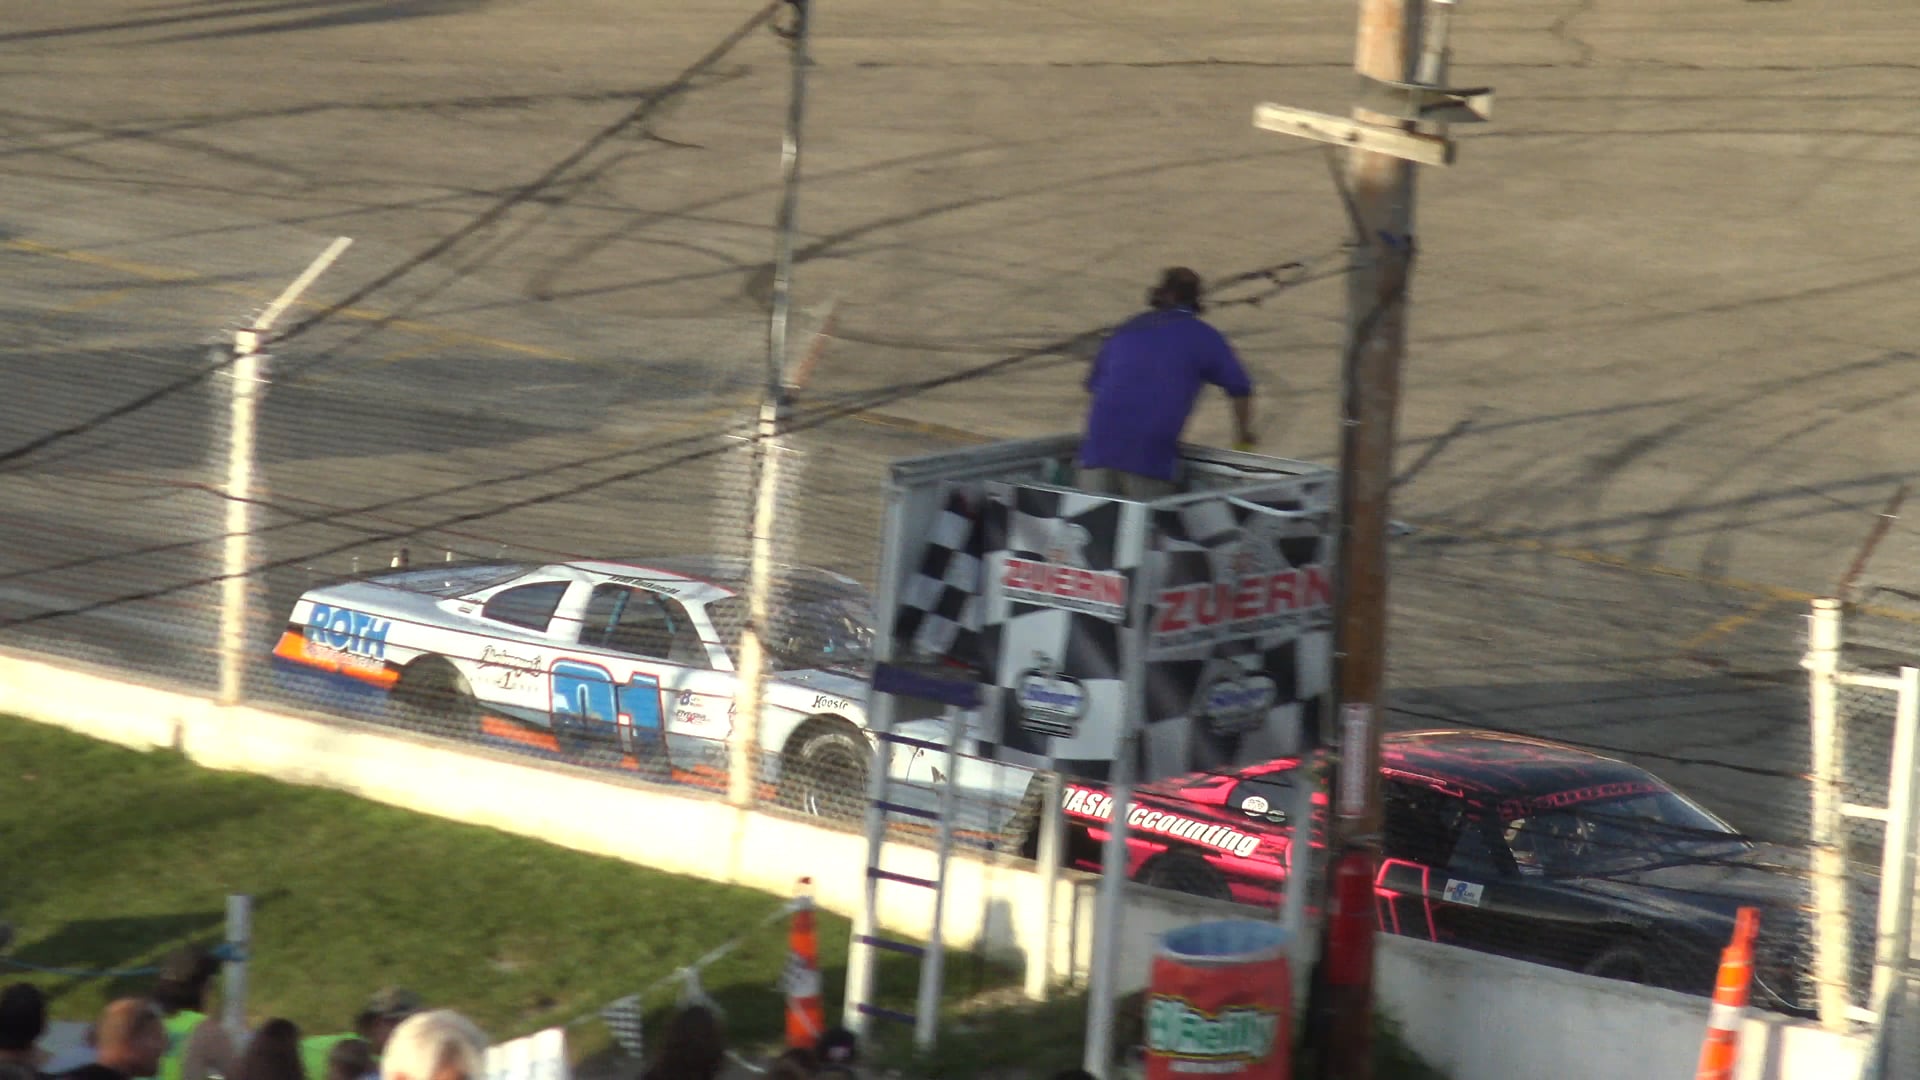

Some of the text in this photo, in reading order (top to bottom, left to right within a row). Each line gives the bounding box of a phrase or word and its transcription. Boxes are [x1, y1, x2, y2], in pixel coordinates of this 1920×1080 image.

[1003, 557, 1125, 606] ZUERN
[1158, 564, 1332, 633] ZUERN
[304, 603, 392, 660] ROTH
